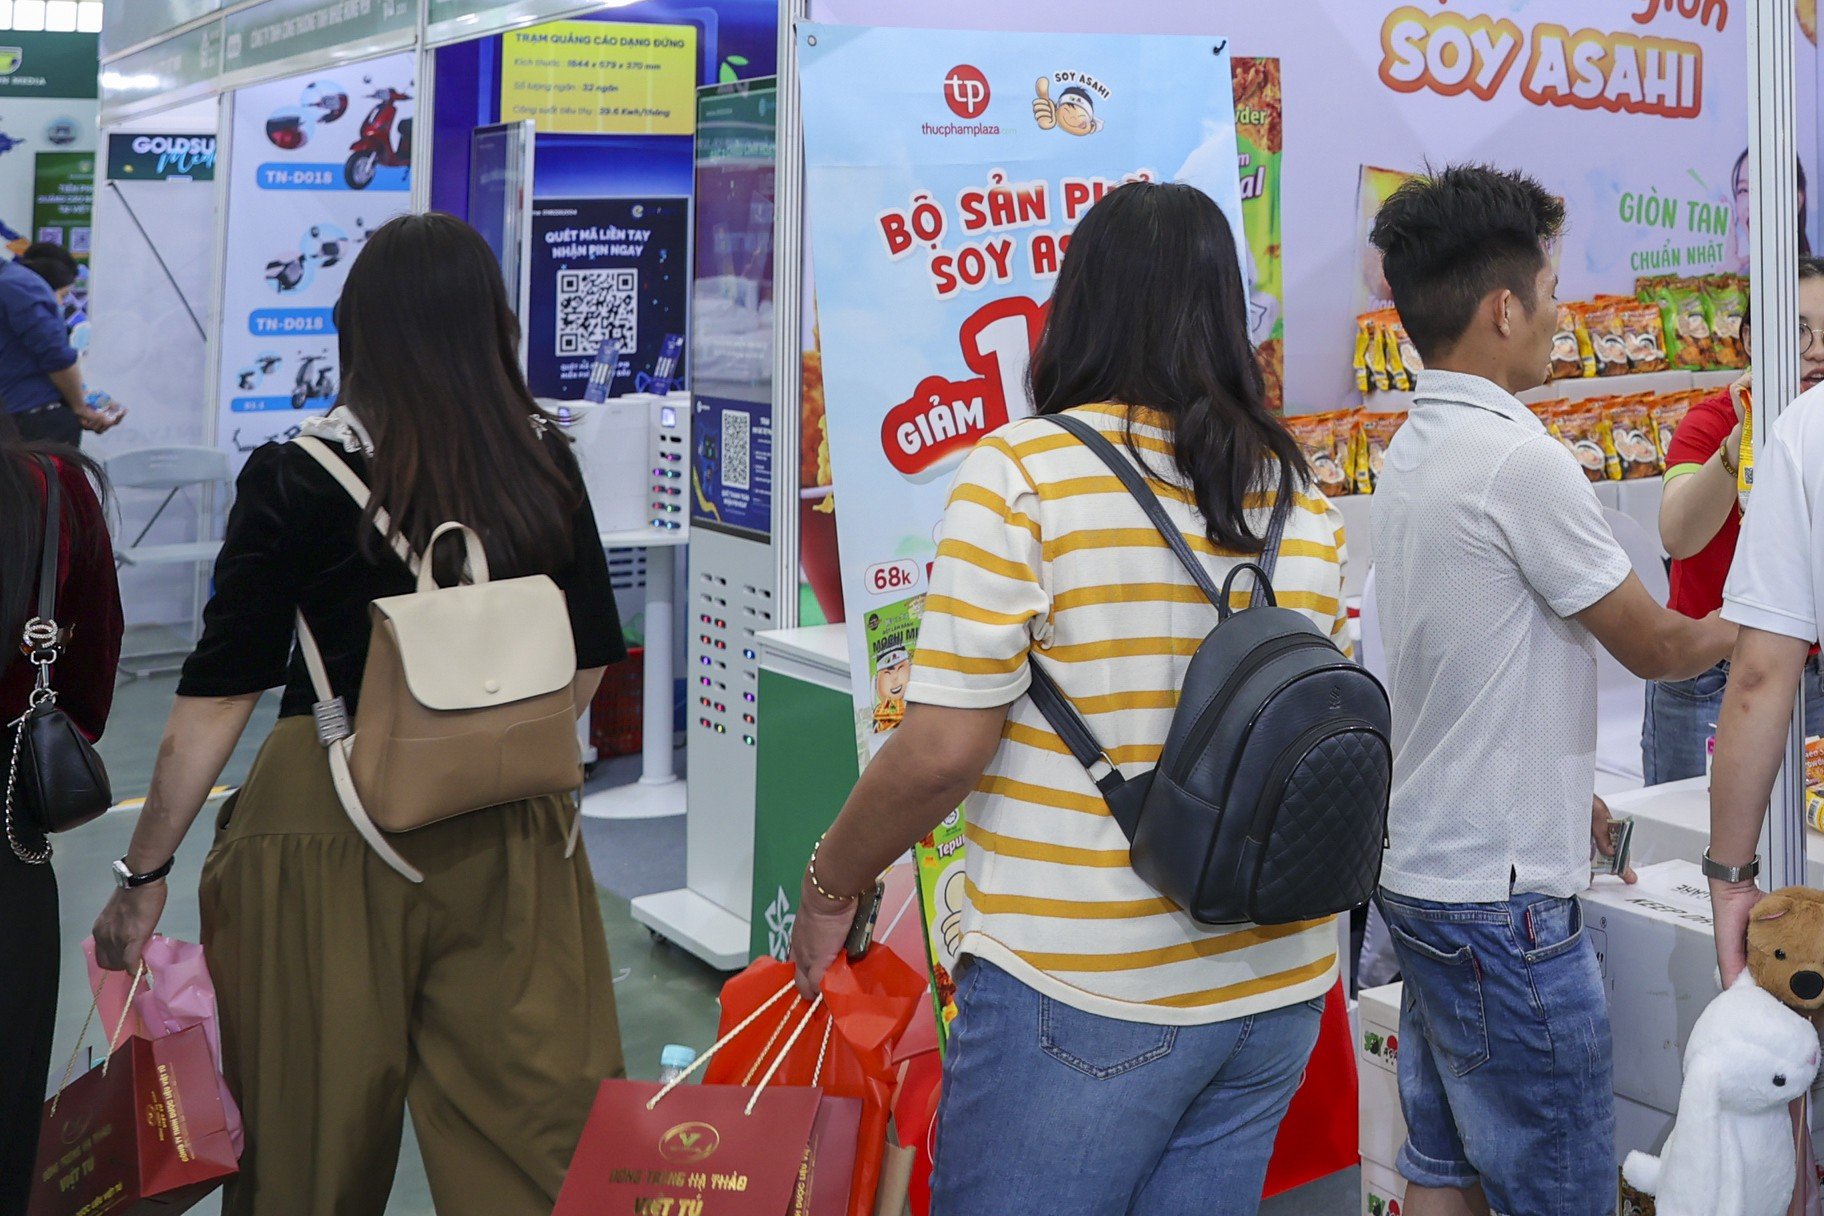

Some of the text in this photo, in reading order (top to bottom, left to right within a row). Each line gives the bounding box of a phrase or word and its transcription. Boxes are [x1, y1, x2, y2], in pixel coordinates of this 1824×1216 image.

[516, 33, 548, 45] TRẠM
[593, 33, 617, 46] CÁO
[1383, 9, 1699, 114] SOY ASAHI
[944, 74, 986, 114] tp
[1054, 71, 1111, 100] SOY ASAHI
[132, 136, 216, 155] GOLDSU
[265, 170, 333, 185] TN-D018
[879, 192, 944, 256] BỘ
[960, 171, 1048, 233] SẢN
[1619, 185, 1729, 236] GIÒN TAN
[545, 227, 578, 244] QUÉT
[579, 226, 599, 242] MÃ
[626, 229, 651, 243] TAY
[552, 244, 644, 260] NHẬN PIN NGAY
[1630, 239, 1724, 273] CHUẨN NHẬT
[930, 238, 1012, 295] SOY
[256, 317, 324, 332] TN-D018
[896, 394, 984, 453] GIẢM
[874, 566, 912, 590] 68k
[711, 1169, 748, 1192] THẢO
